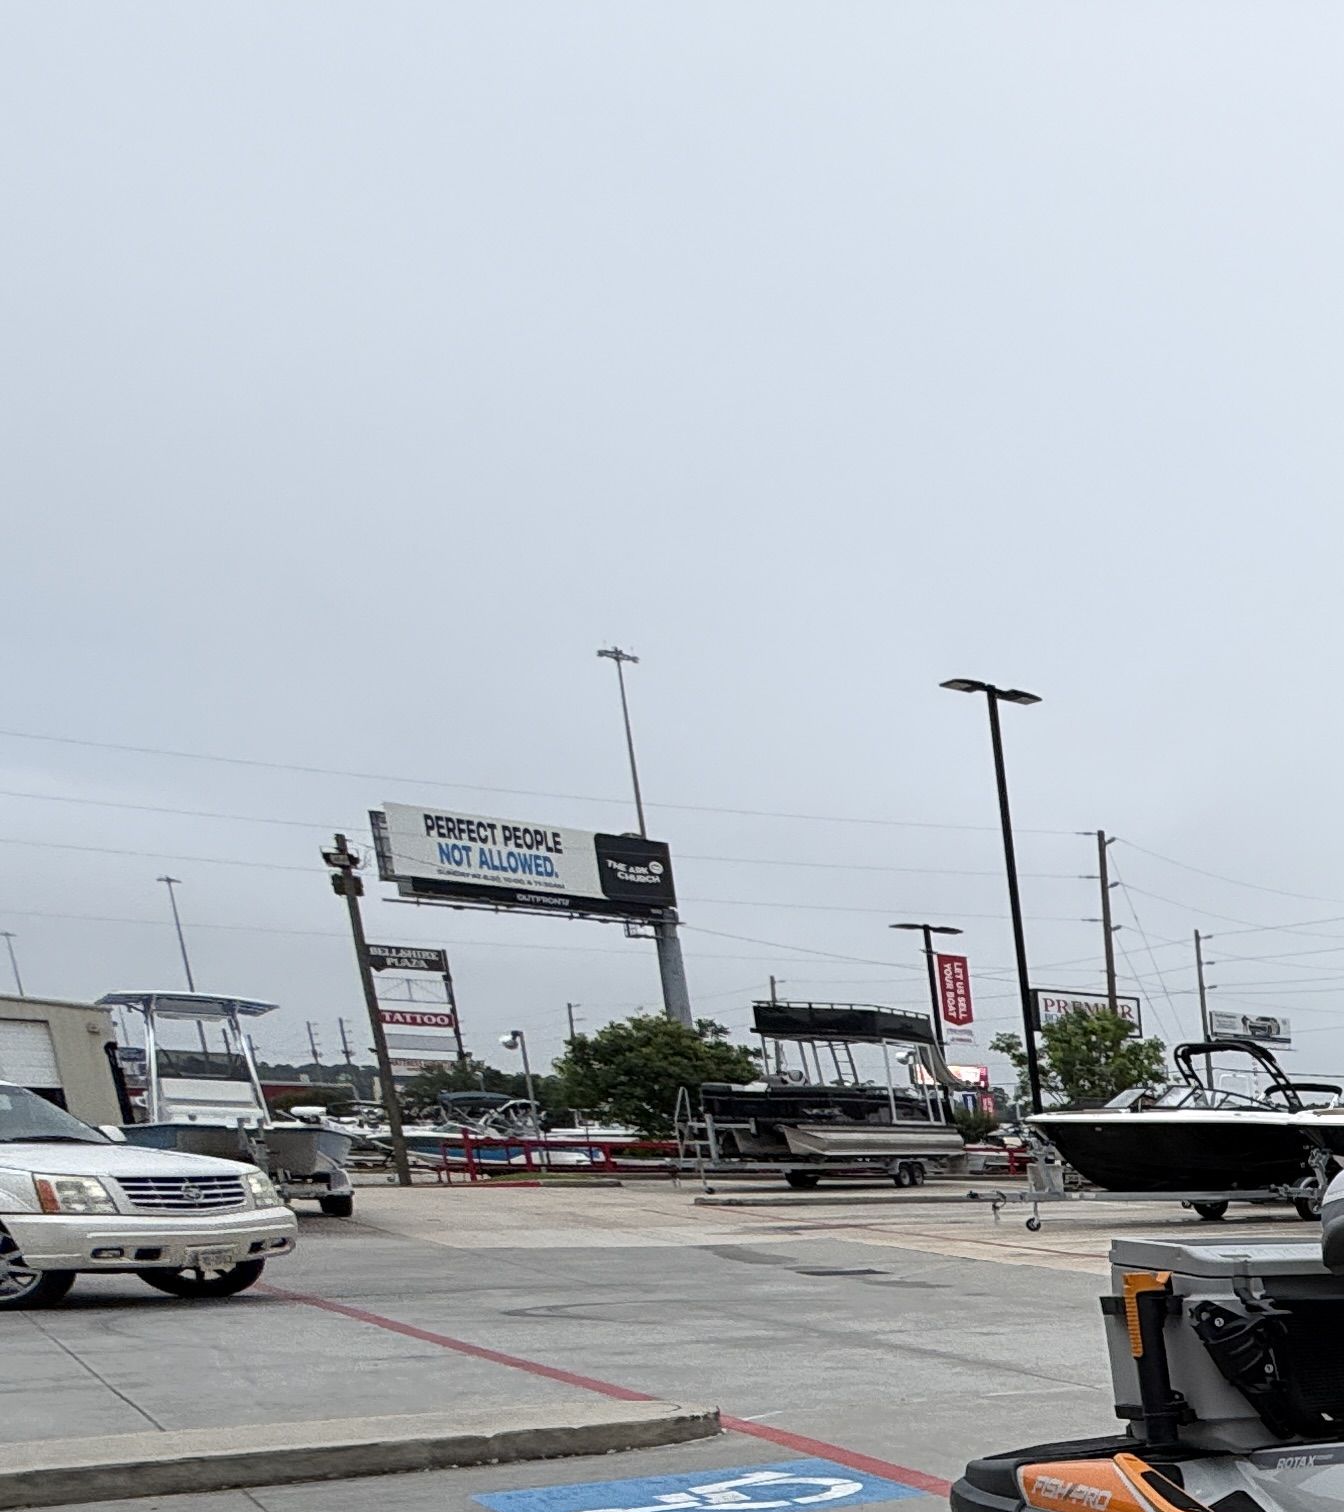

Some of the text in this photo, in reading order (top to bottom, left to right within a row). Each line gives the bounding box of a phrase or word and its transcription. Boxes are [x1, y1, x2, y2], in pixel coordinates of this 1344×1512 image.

[423, 813, 563, 854] PERFECT PEOPLE
[438, 843, 559, 878] NOT ALLOWED.
[606, 859, 649, 874] THE ARK
[617, 872, 661, 883] CHURCH
[385, 957, 429, 969] PLAZA
[953, 962, 964, 980] LET
[943, 963, 957, 1019] YOUR BOAT
[956, 981, 965, 995] US
[957, 996, 968, 1021] SELL
[381, 1011, 450, 1025] TATTOO
